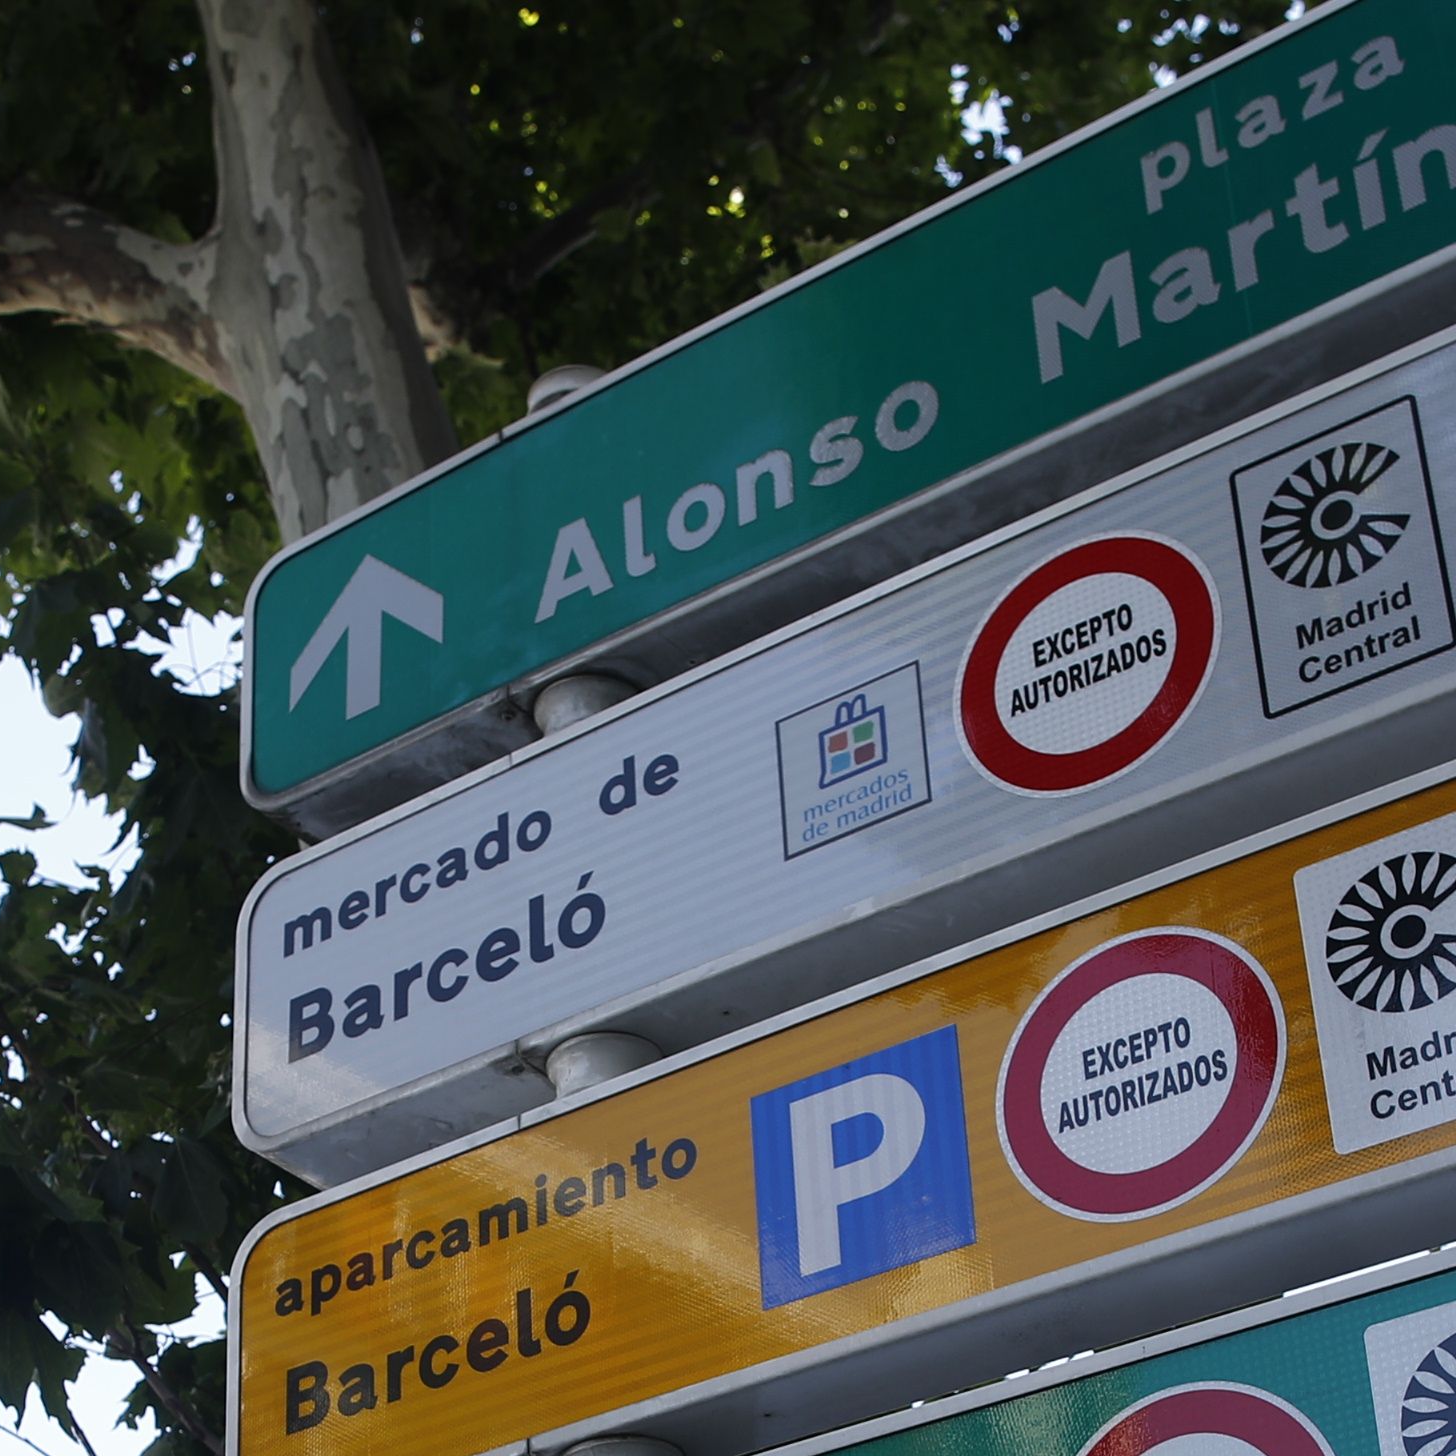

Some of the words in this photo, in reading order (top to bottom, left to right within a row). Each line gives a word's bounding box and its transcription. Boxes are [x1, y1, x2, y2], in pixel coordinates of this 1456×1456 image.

[1140, 34, 1405, 215] plaza
[535, 380, 939, 624] Alonso
[1032, 603, 1133, 668] EXCEPTO
[1295, 582, 1413, 649] Madrid
[1298, 616, 1421, 684] Central
[1010, 629, 1167, 717] AUTORIZADOS
[802, 821, 829, 842] de
[837, 784, 913, 828] madrid
[803, 769, 909, 823] mercados
[283, 809, 552, 958] mercado
[599, 754, 680, 815] de
[288, 870, 607, 1063] Barceló
[1058, 1049, 1228, 1133] AUTORIZADOS
[1082, 1016, 1191, 1081] EXCEPTO
[789, 1073, 926, 1278] P
[275, 1136, 697, 1317] aparcamiento
[285, 1270, 592, 1435] Barceló
